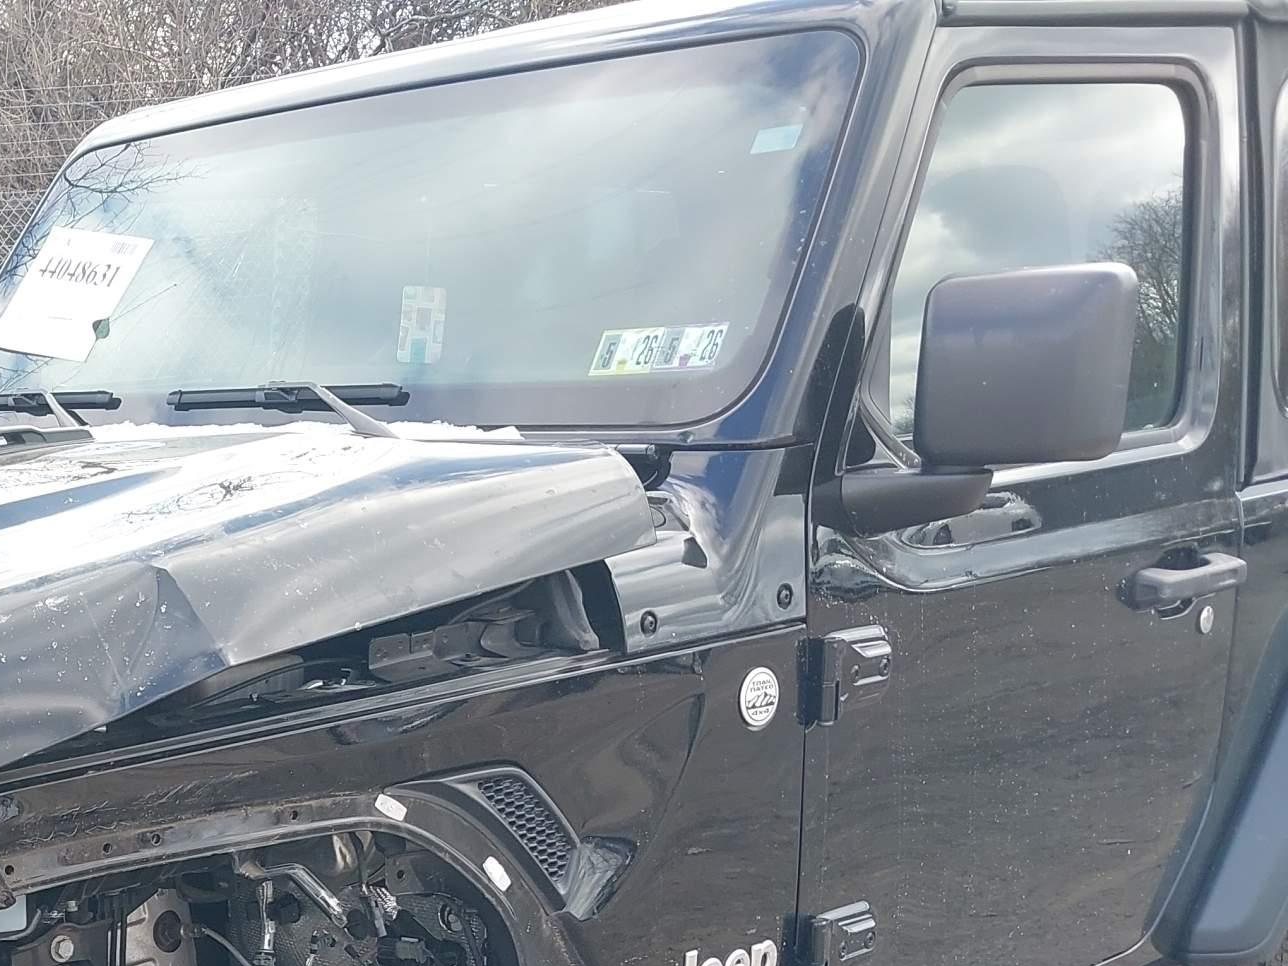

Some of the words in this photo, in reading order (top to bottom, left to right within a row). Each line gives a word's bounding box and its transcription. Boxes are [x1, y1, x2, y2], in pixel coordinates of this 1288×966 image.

[38, 255, 121, 287] 44048631
[601, 342, 616, 368] 5
[635, 334, 659, 365] 26
[699, 329, 724, 361] 26
